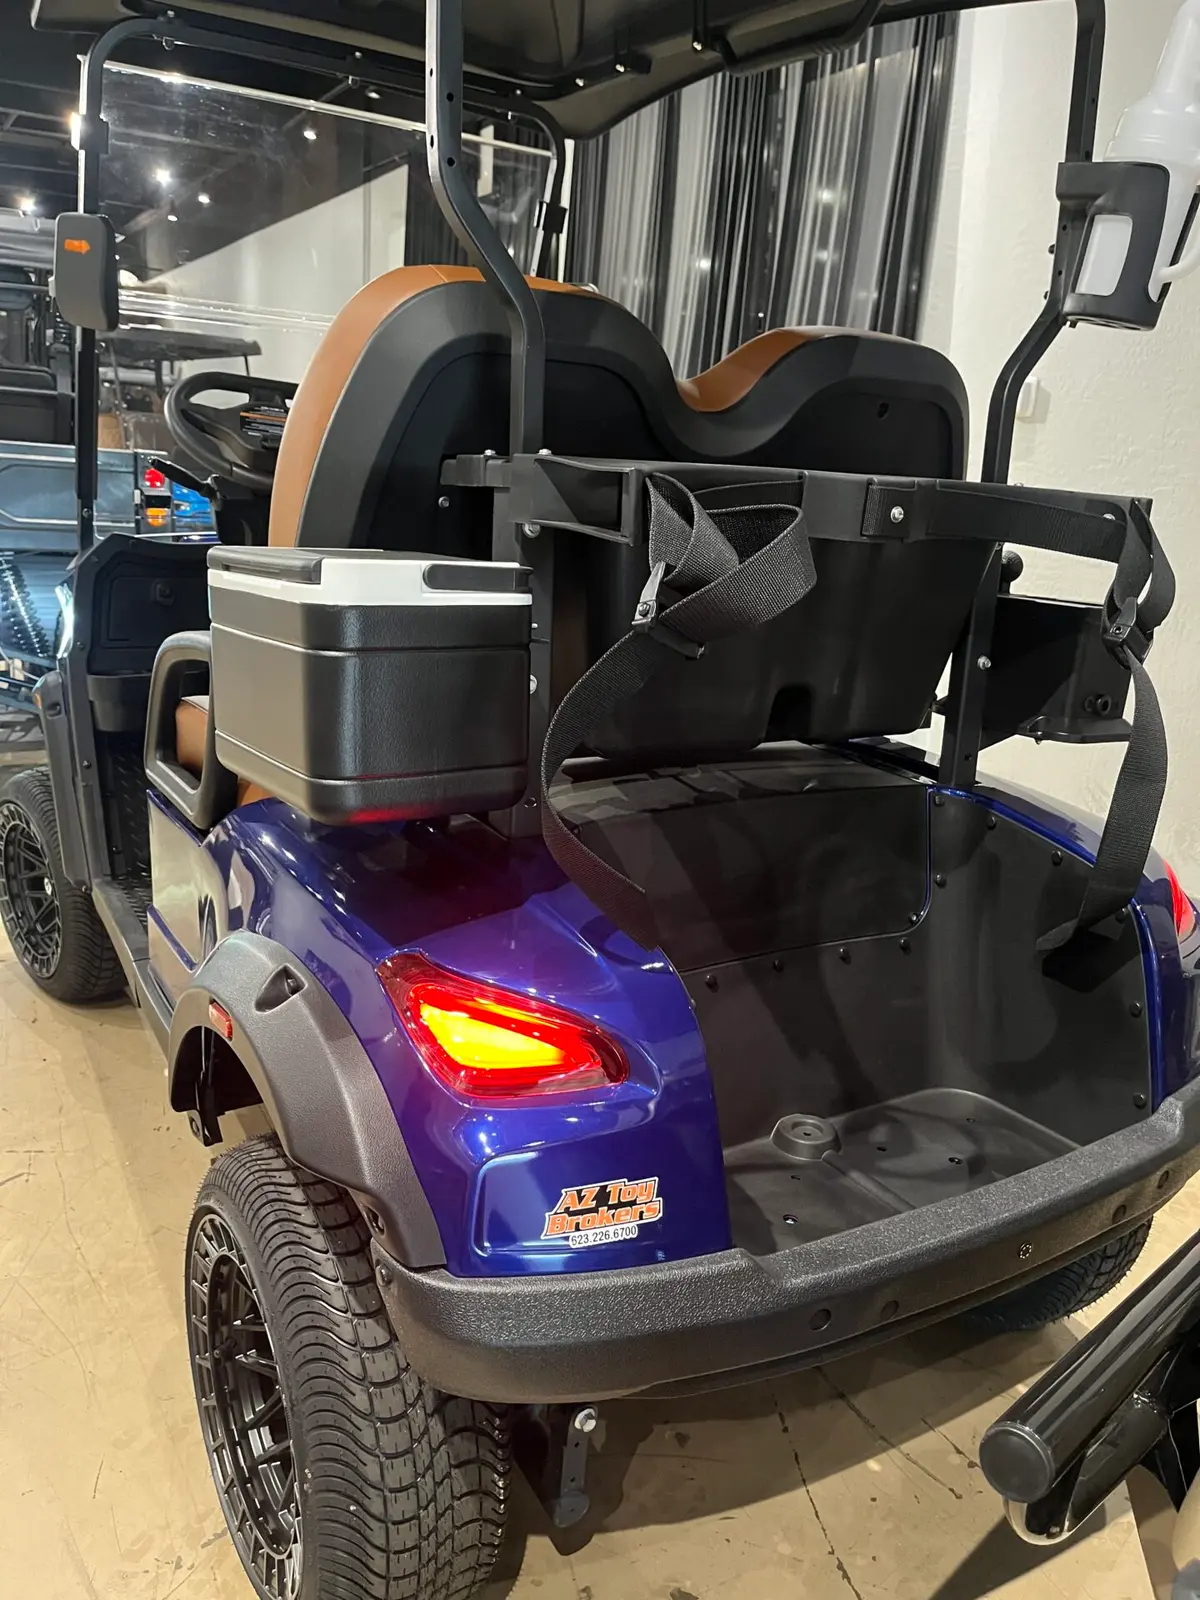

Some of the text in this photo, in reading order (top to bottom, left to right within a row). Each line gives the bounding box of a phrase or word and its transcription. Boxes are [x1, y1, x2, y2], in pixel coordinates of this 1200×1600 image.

[557, 1181, 655, 1212] AZ Toy
[546, 1200, 661, 1235] Brokers
[571, 1225, 638, 1246] 623.226.6700
